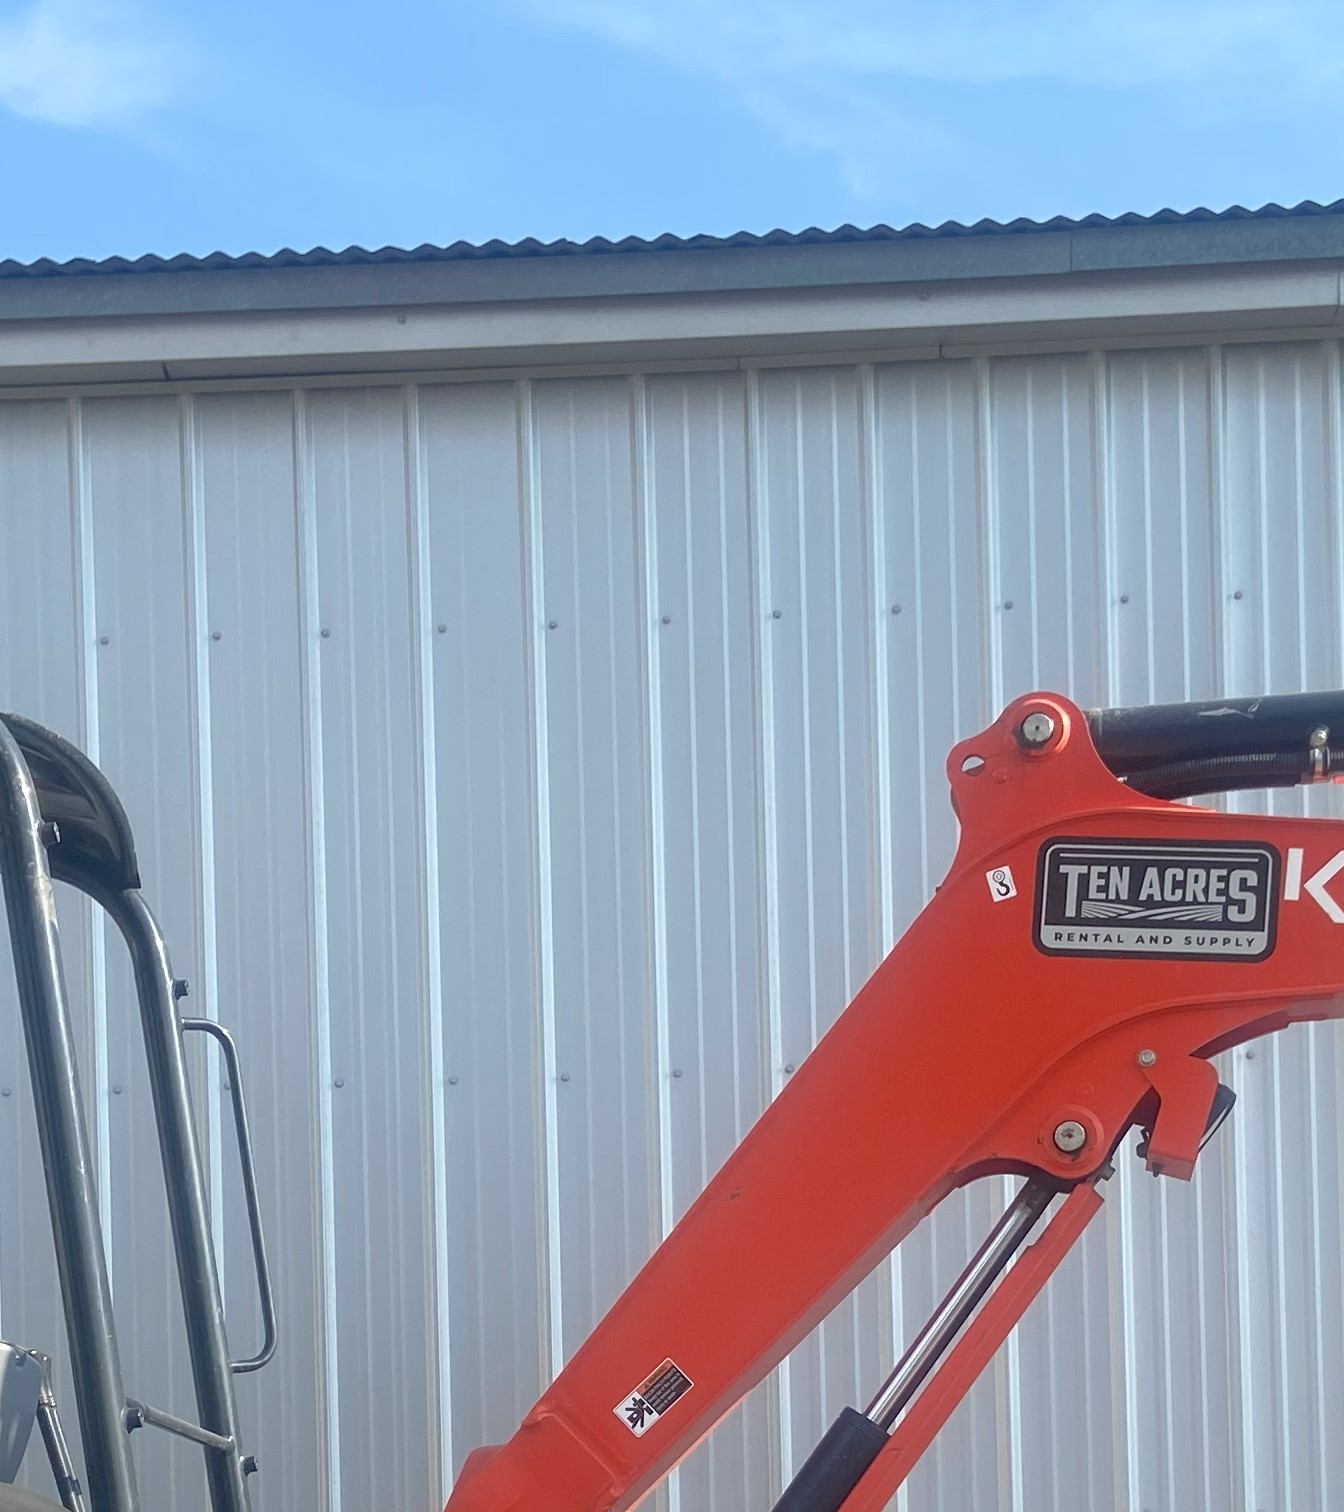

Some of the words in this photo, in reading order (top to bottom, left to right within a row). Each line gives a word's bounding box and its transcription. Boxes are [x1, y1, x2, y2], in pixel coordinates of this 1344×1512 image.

[1058, 863, 1131, 919] TEN
[1138, 866, 1259, 924] ACRES
[1053, 931, 1125, 945] RENTAL
[1135, 934, 1174, 946] AND
[1183, 934, 1257, 948] SUPPLY
